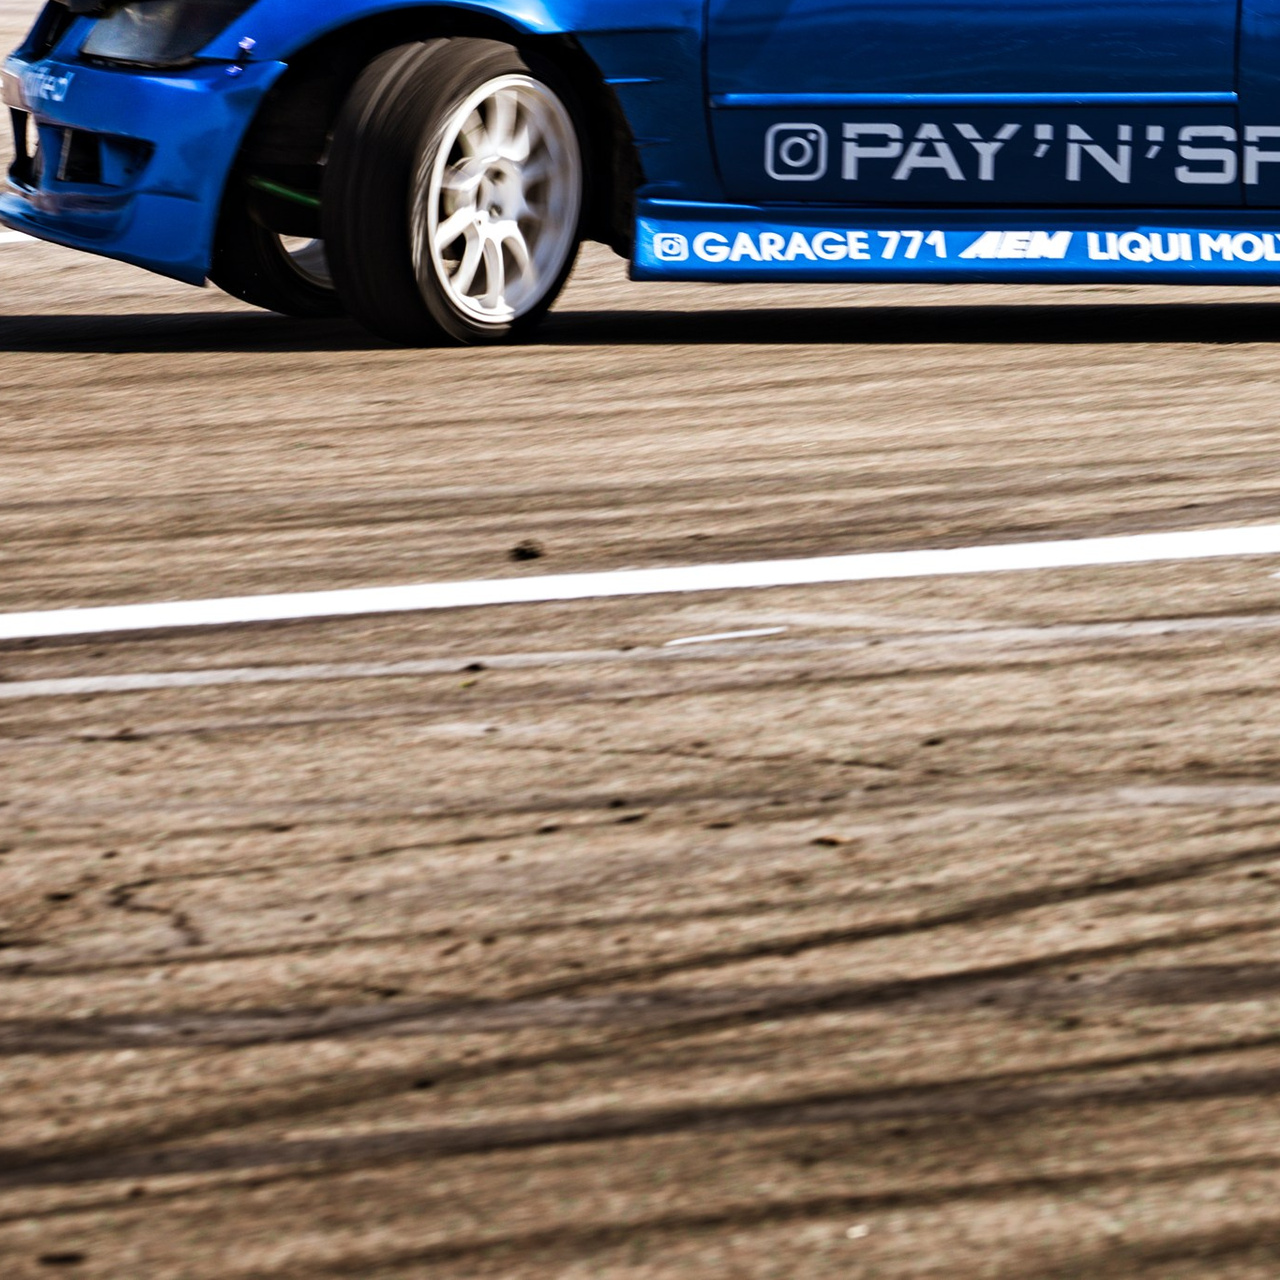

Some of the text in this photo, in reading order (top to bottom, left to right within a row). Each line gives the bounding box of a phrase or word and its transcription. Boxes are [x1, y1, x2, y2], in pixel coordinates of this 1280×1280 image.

[693, 230, 947, 262] GARAGE 771
[958, 231, 1074, 259] AEM
[1086, 231, 1193, 262] LIQUI
